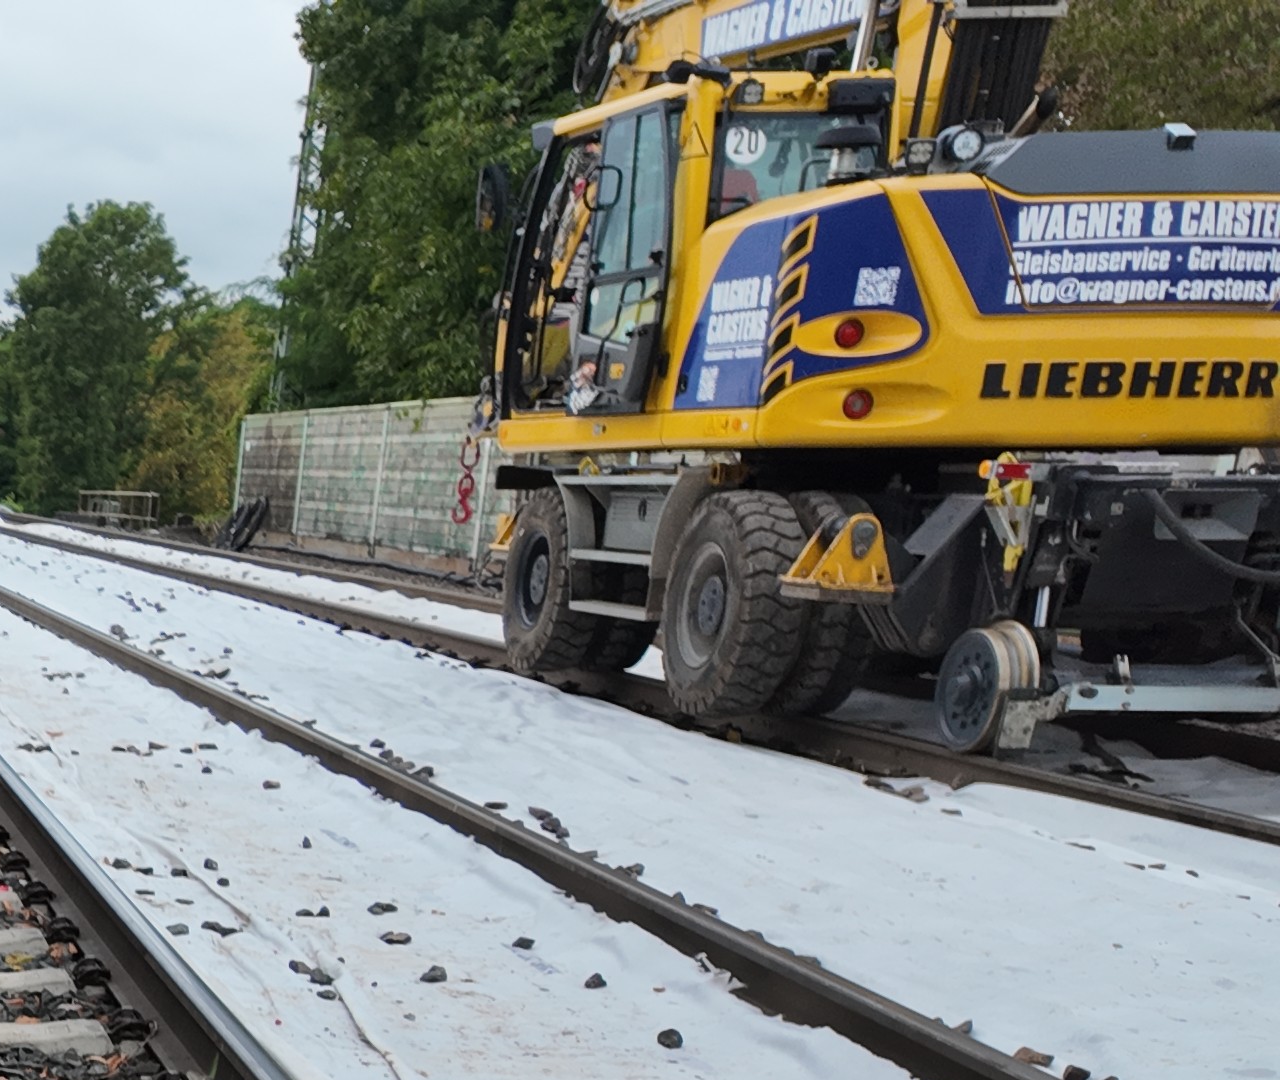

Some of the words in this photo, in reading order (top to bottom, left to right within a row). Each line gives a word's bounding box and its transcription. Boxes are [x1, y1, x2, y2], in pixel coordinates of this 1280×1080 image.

[703, 1, 769, 58] WAGNER
[733, 129, 759, 155] 20
[1018, 201, 1144, 242] WAGNER
[1151, 200, 1174, 237] &
[1009, 247, 1171, 276] Gleisbauservice
[711, 276, 760, 313] WAGNER
[706, 309, 768, 345] CARSTENS
[979, 360, 1279, 399] LIEBHERR
